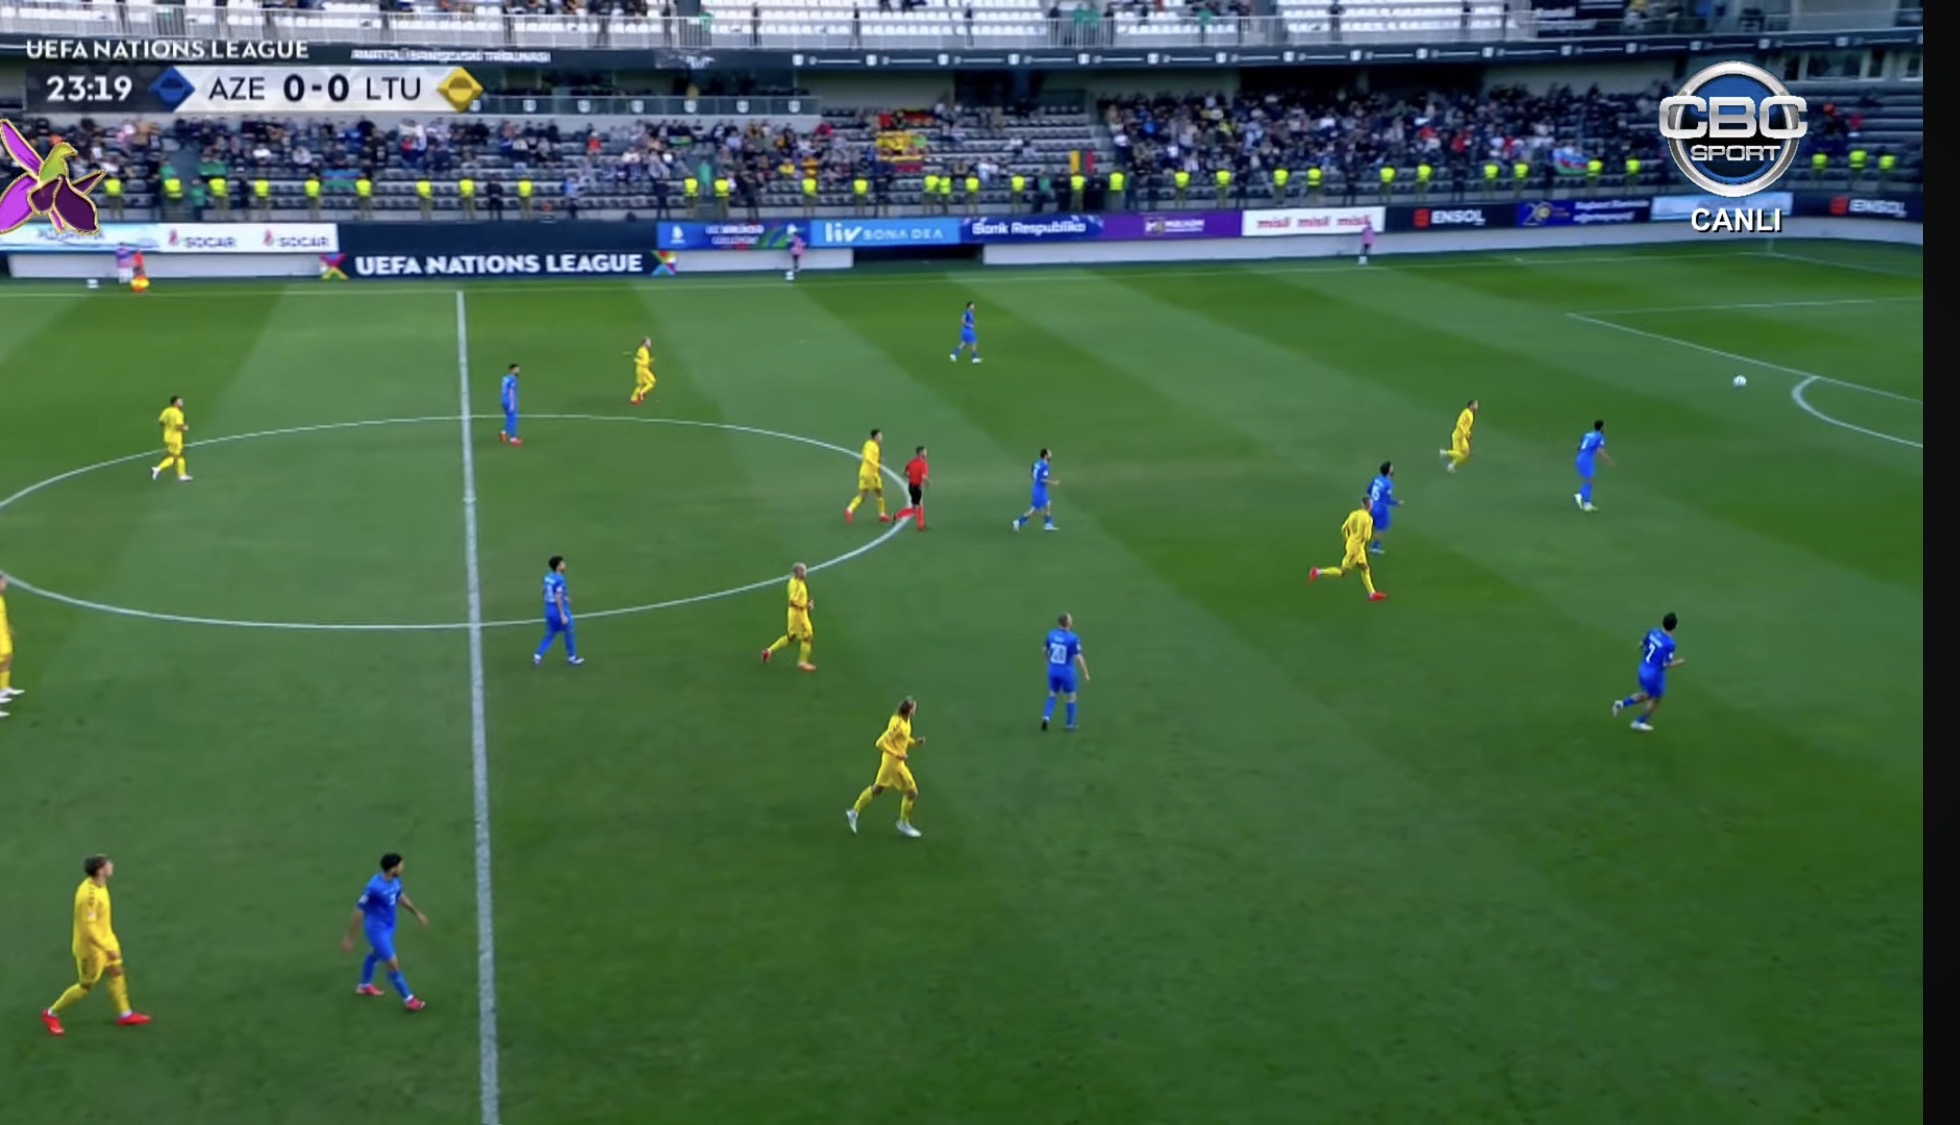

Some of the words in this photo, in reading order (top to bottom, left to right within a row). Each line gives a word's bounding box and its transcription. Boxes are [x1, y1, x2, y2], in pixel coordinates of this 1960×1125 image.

[1431, 209, 1486, 226] ENSOL
[911, 228, 945, 240] DEA
[355, 255, 422, 276] UEFA
[426, 255, 541, 276] NATIONS
[547, 254, 643, 275] LEAGUE
[1050, 642, 1067, 664] 20
[1646, 643, 1656, 663] 7
